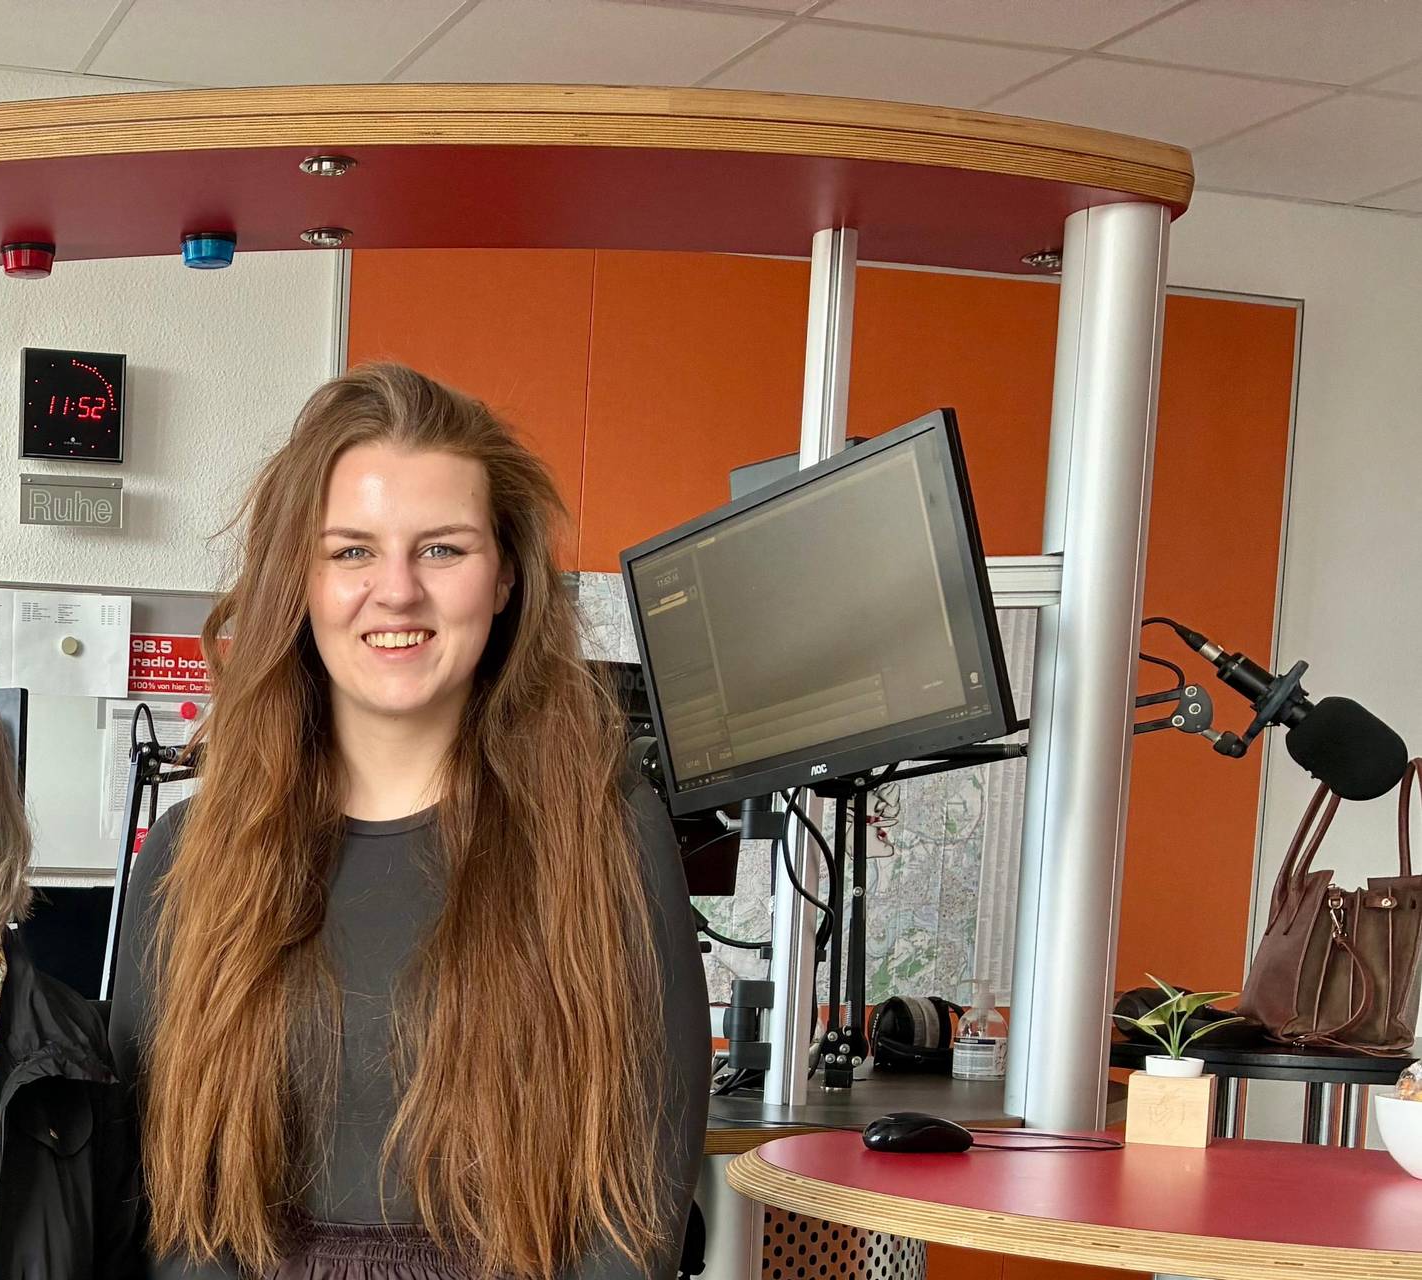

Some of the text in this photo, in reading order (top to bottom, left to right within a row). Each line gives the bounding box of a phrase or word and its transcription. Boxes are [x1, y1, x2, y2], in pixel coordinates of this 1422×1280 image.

[49, 395, 106, 419] 11:52
[28, 488, 113, 523] Ruhe
[132, 640, 173, 654] 98.5
[133, 656, 175, 668] radio
[132, 682, 156, 690] 100%
[172, 683, 187, 691] hier.
[810, 763, 828, 776] AOC
